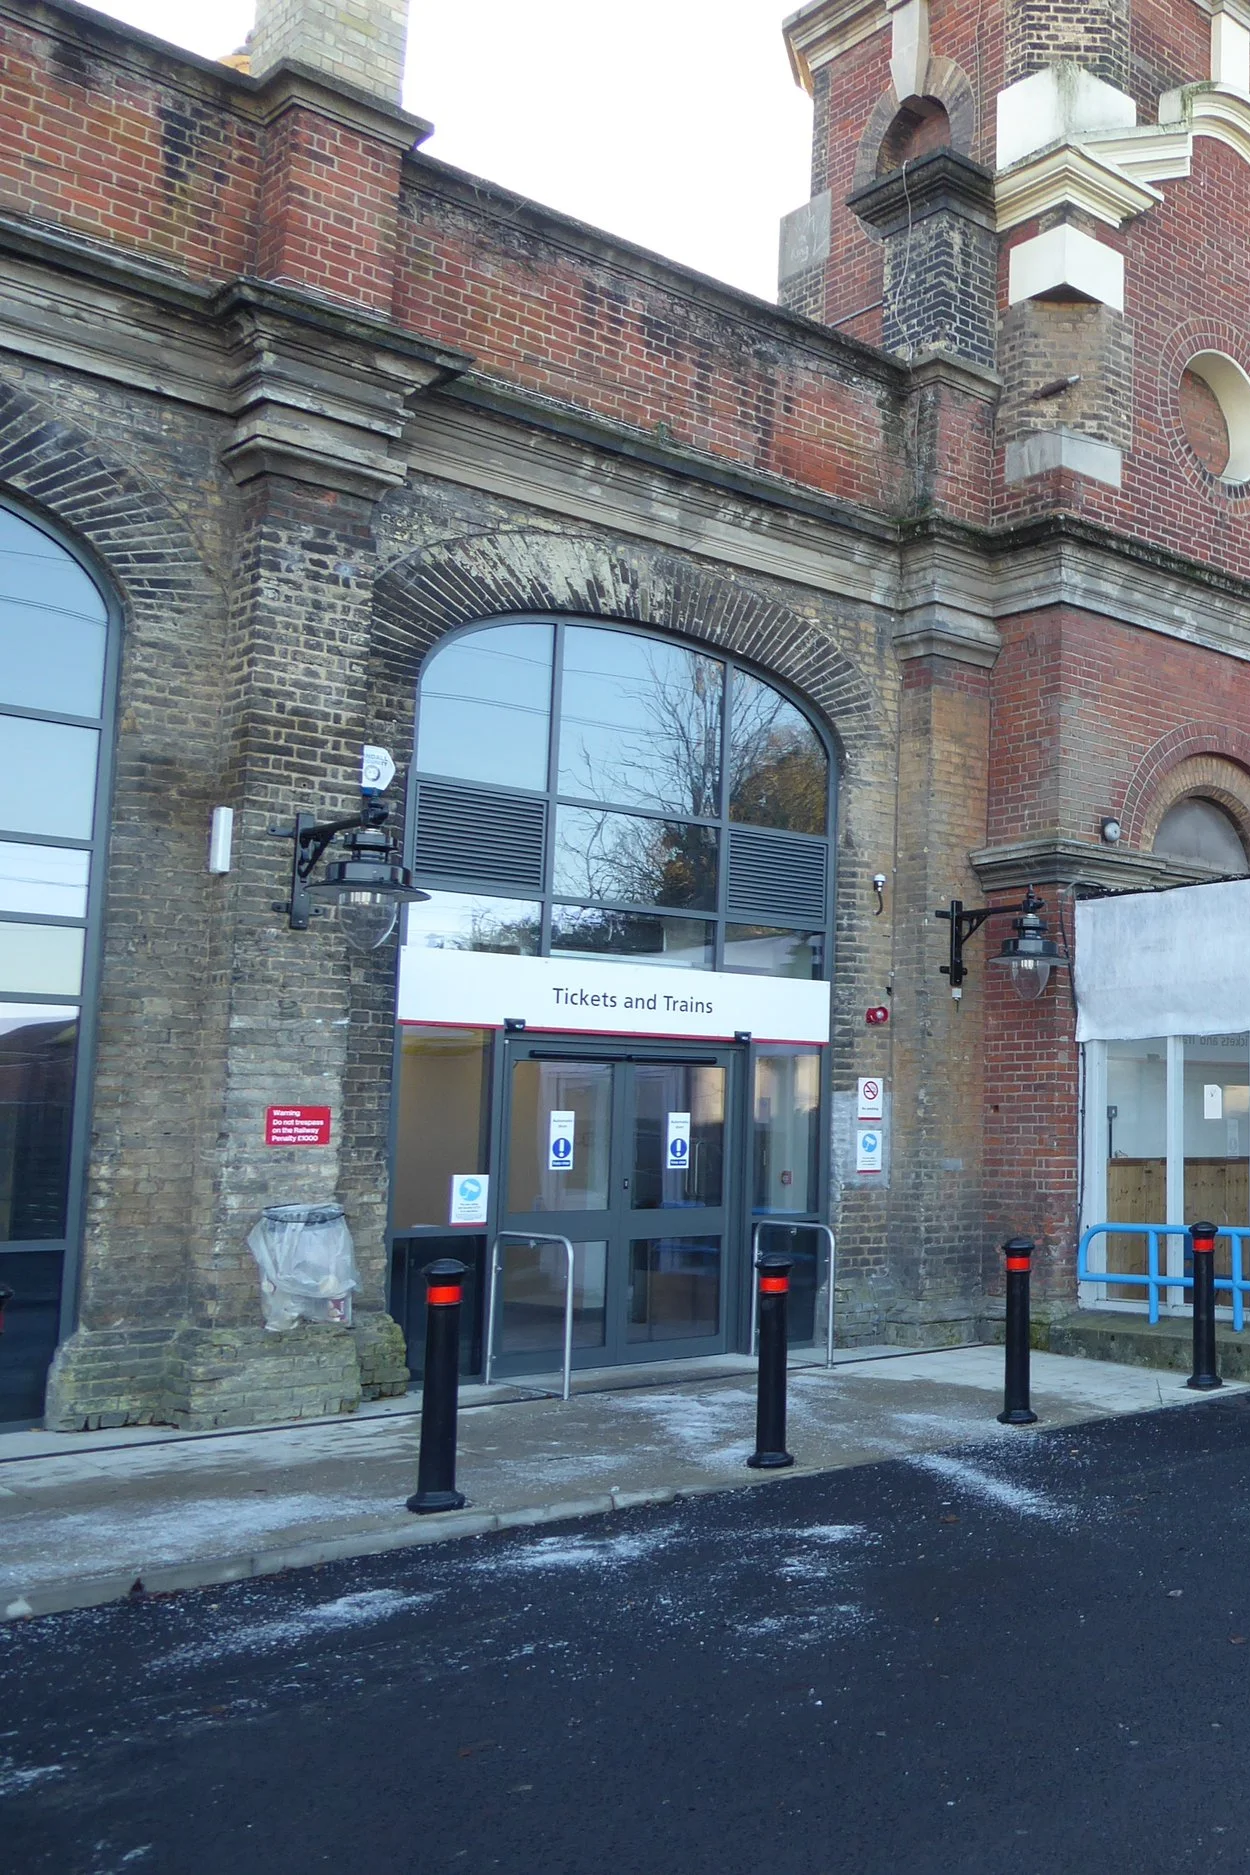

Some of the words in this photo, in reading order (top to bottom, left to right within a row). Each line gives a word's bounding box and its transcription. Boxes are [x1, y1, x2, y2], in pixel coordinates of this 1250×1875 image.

[552, 987, 618, 1008] Tickets
[623, 994, 657, 1010] and
[663, 995, 713, 1014] Trains
[273, 1109, 301, 1117] Warning
[295, 1119, 324, 1127] trespass
[294, 1127, 320, 1135] Railway
